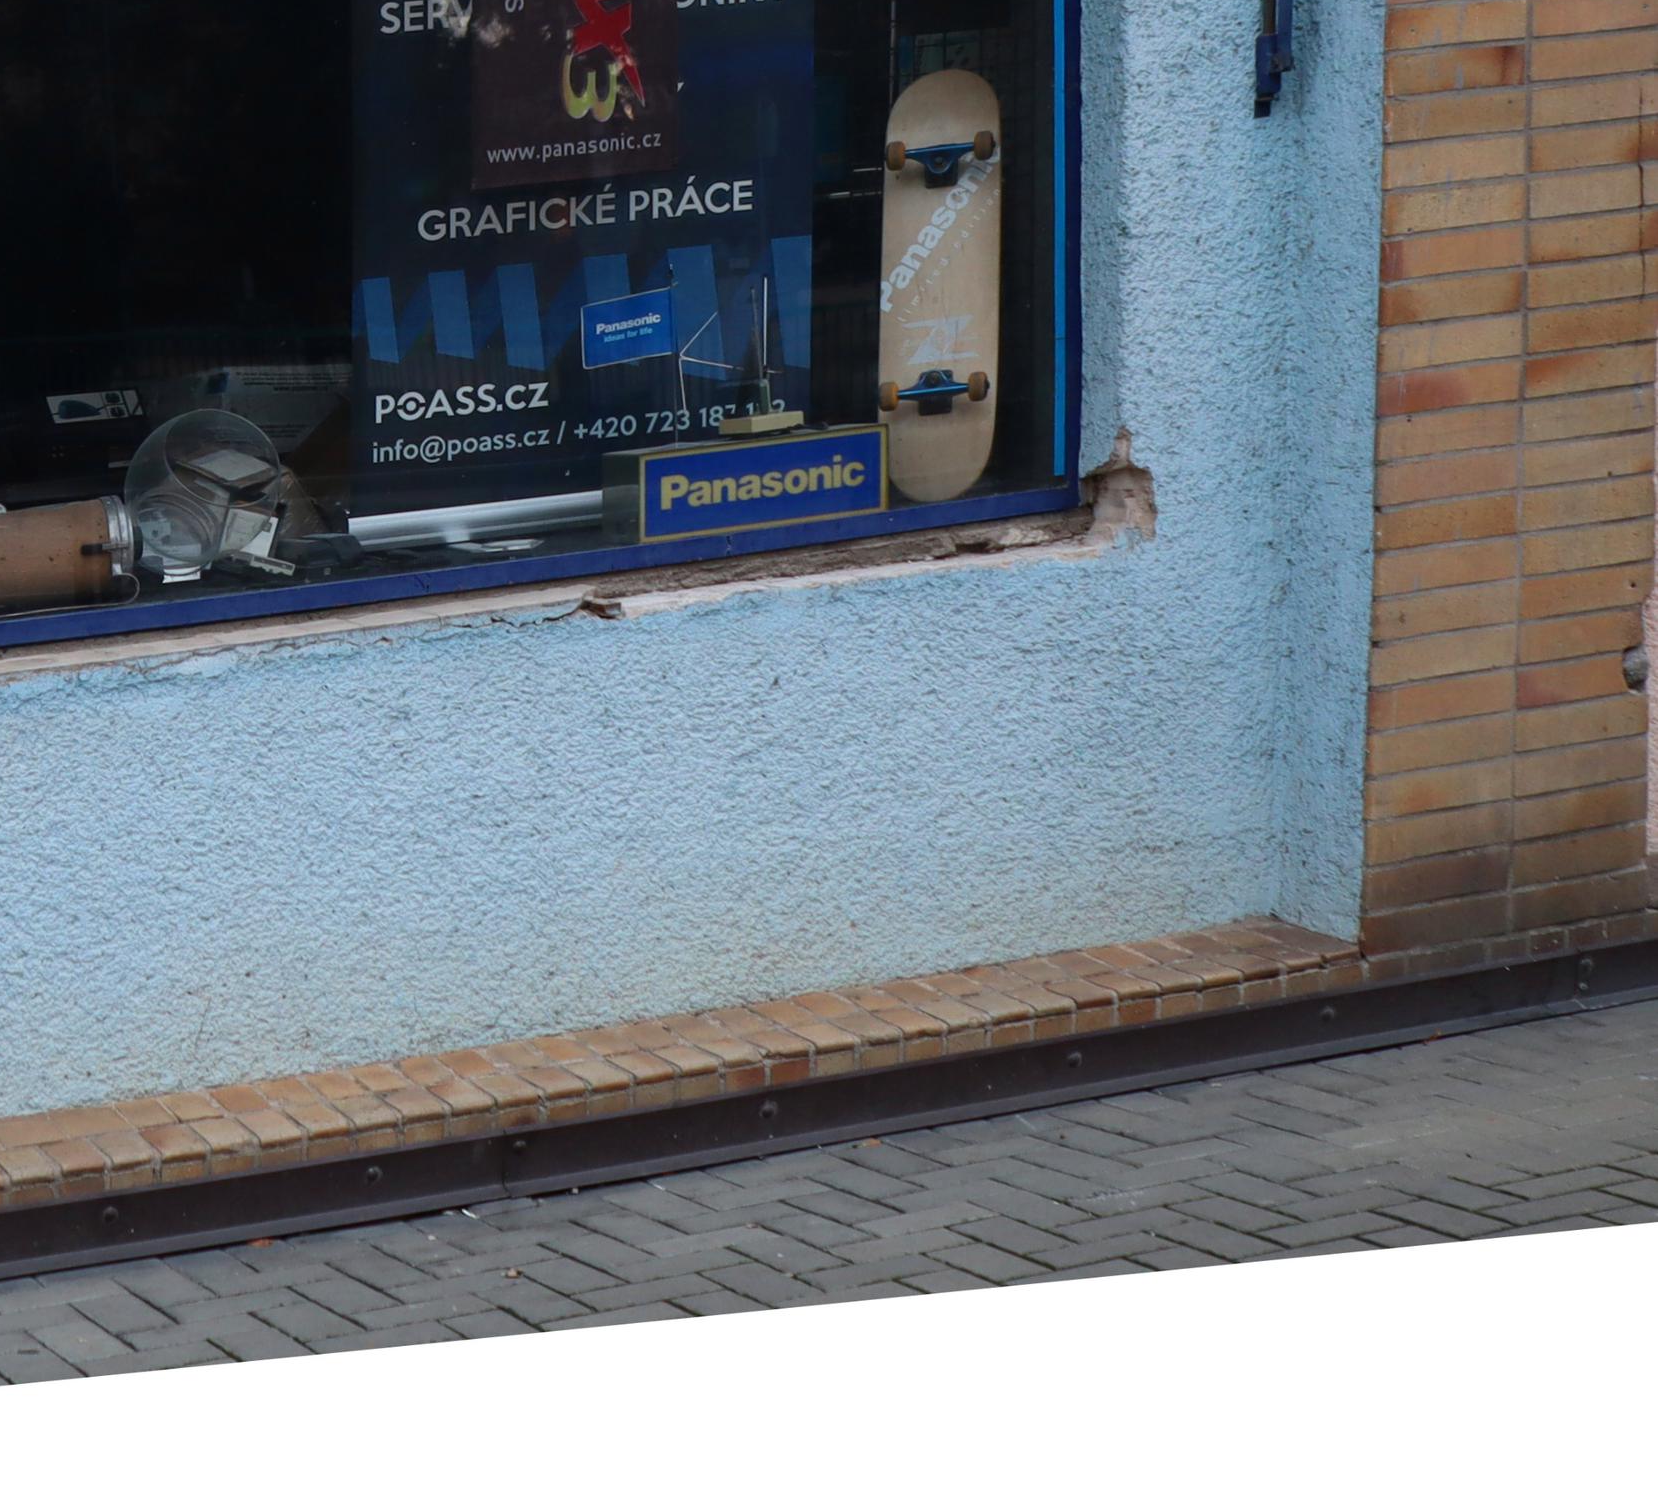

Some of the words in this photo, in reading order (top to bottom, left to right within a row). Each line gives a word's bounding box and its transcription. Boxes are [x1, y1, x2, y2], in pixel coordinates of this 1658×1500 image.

[486, 130, 663, 164] www.panasonic.cz
[417, 184, 617, 242] GRAFICKÉ
[627, 175, 755, 221] PRÁCE
[596, 312, 662, 335] Panasonic
[374, 381, 550, 424] POASS.CZ
[372, 427, 550, 464] info@poass.cz
[573, 414, 638, 440] +420
[645, 410, 692, 435] 723
[660, 454, 866, 511] Panasonic
